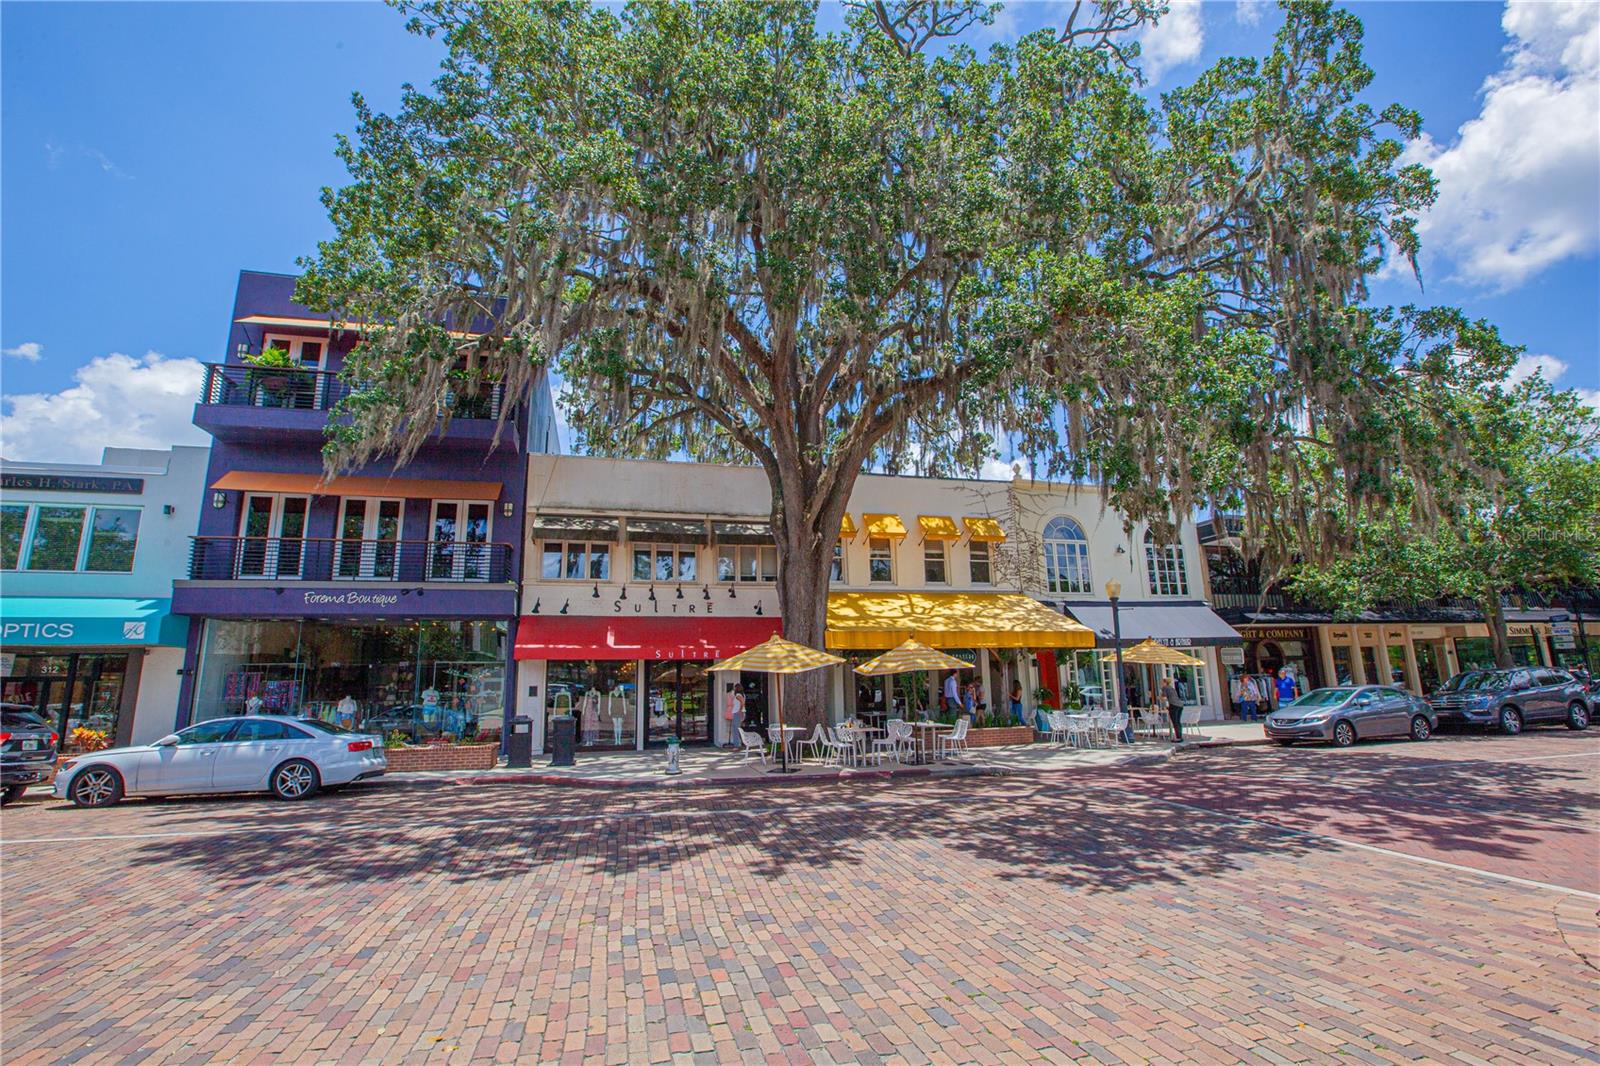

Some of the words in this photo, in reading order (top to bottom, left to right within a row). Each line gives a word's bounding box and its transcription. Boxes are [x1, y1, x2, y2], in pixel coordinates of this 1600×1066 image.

[304, 591, 345, 605] Forema
[346, 591, 398, 608] Boutique
[1, 623, 74, 638] PTICS
[1266, 629, 1304, 639] COMPANY
[41, 665, 59, 674] 312
